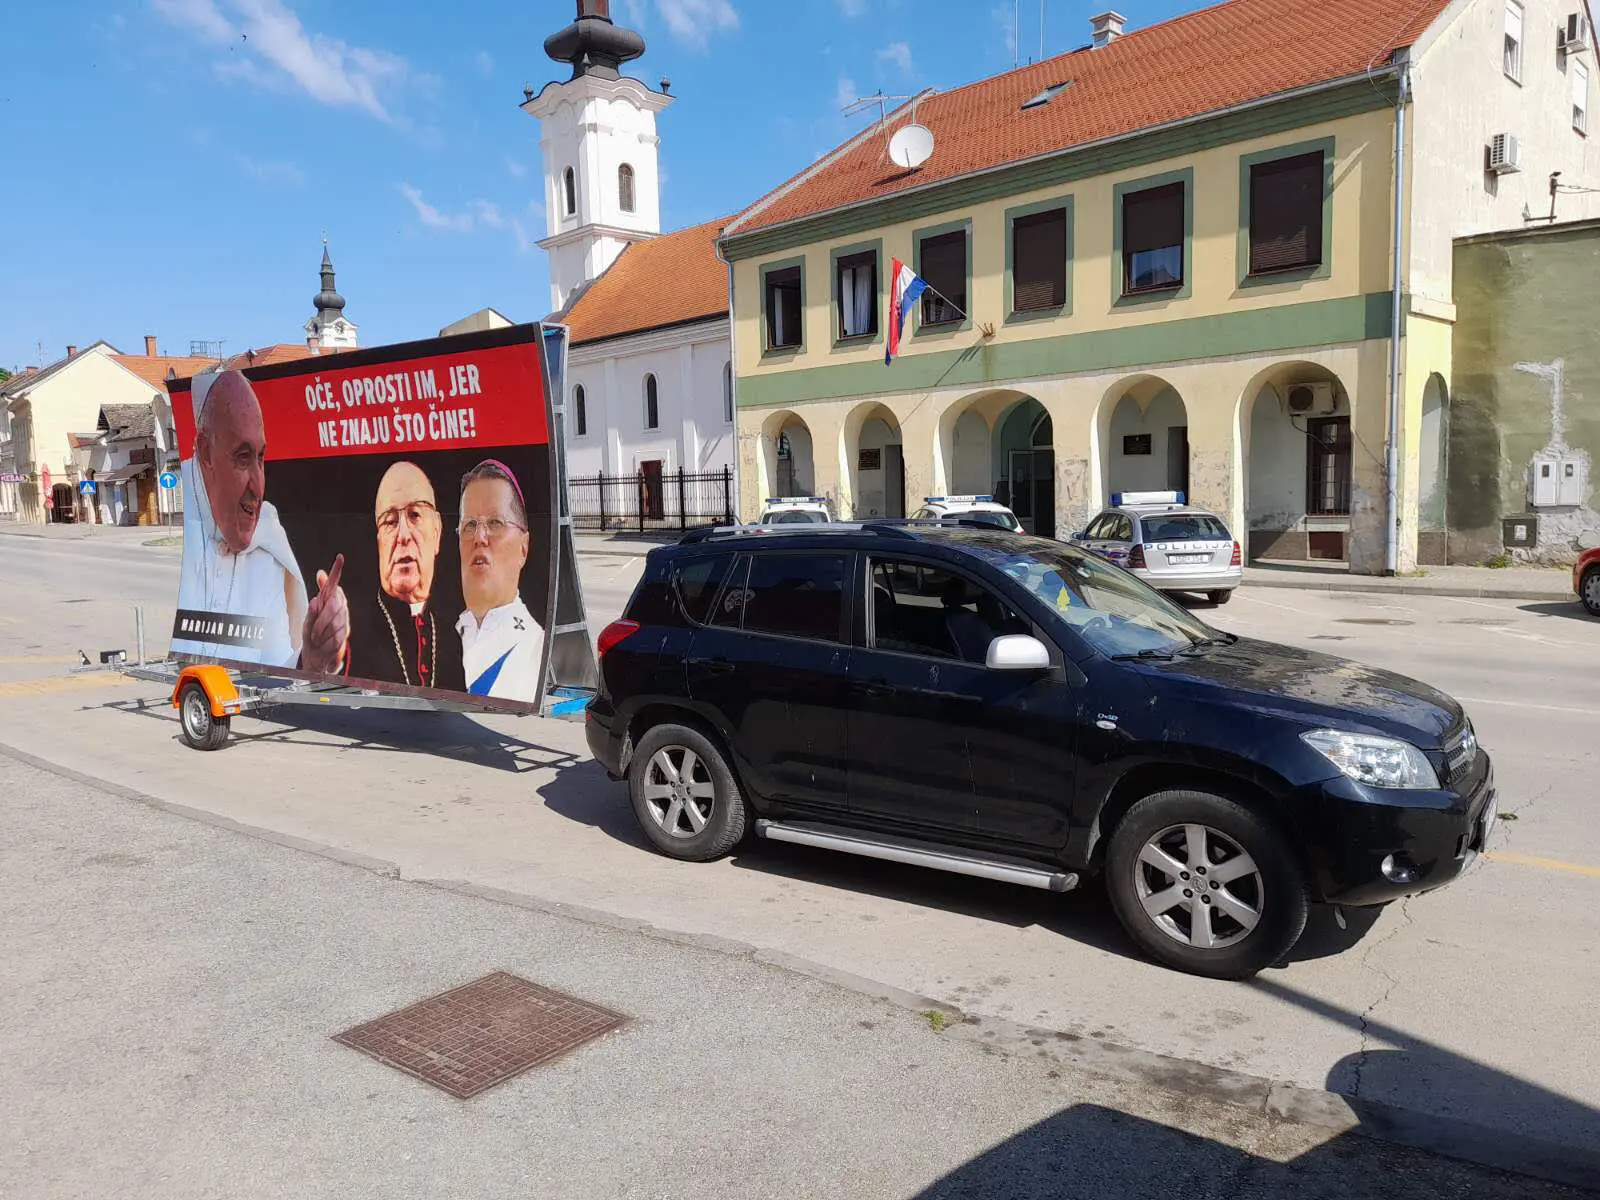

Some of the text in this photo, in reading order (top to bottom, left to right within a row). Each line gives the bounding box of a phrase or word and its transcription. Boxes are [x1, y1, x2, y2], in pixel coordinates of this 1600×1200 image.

[305, 363, 482, 412] OČE, OPROSTI IM, JER
[318, 403, 476, 448] NE ZNAJU ŠTO ČINE!
[1144, 542, 1232, 551] POLICIJA
[181, 618, 225, 636] MARIJAN
